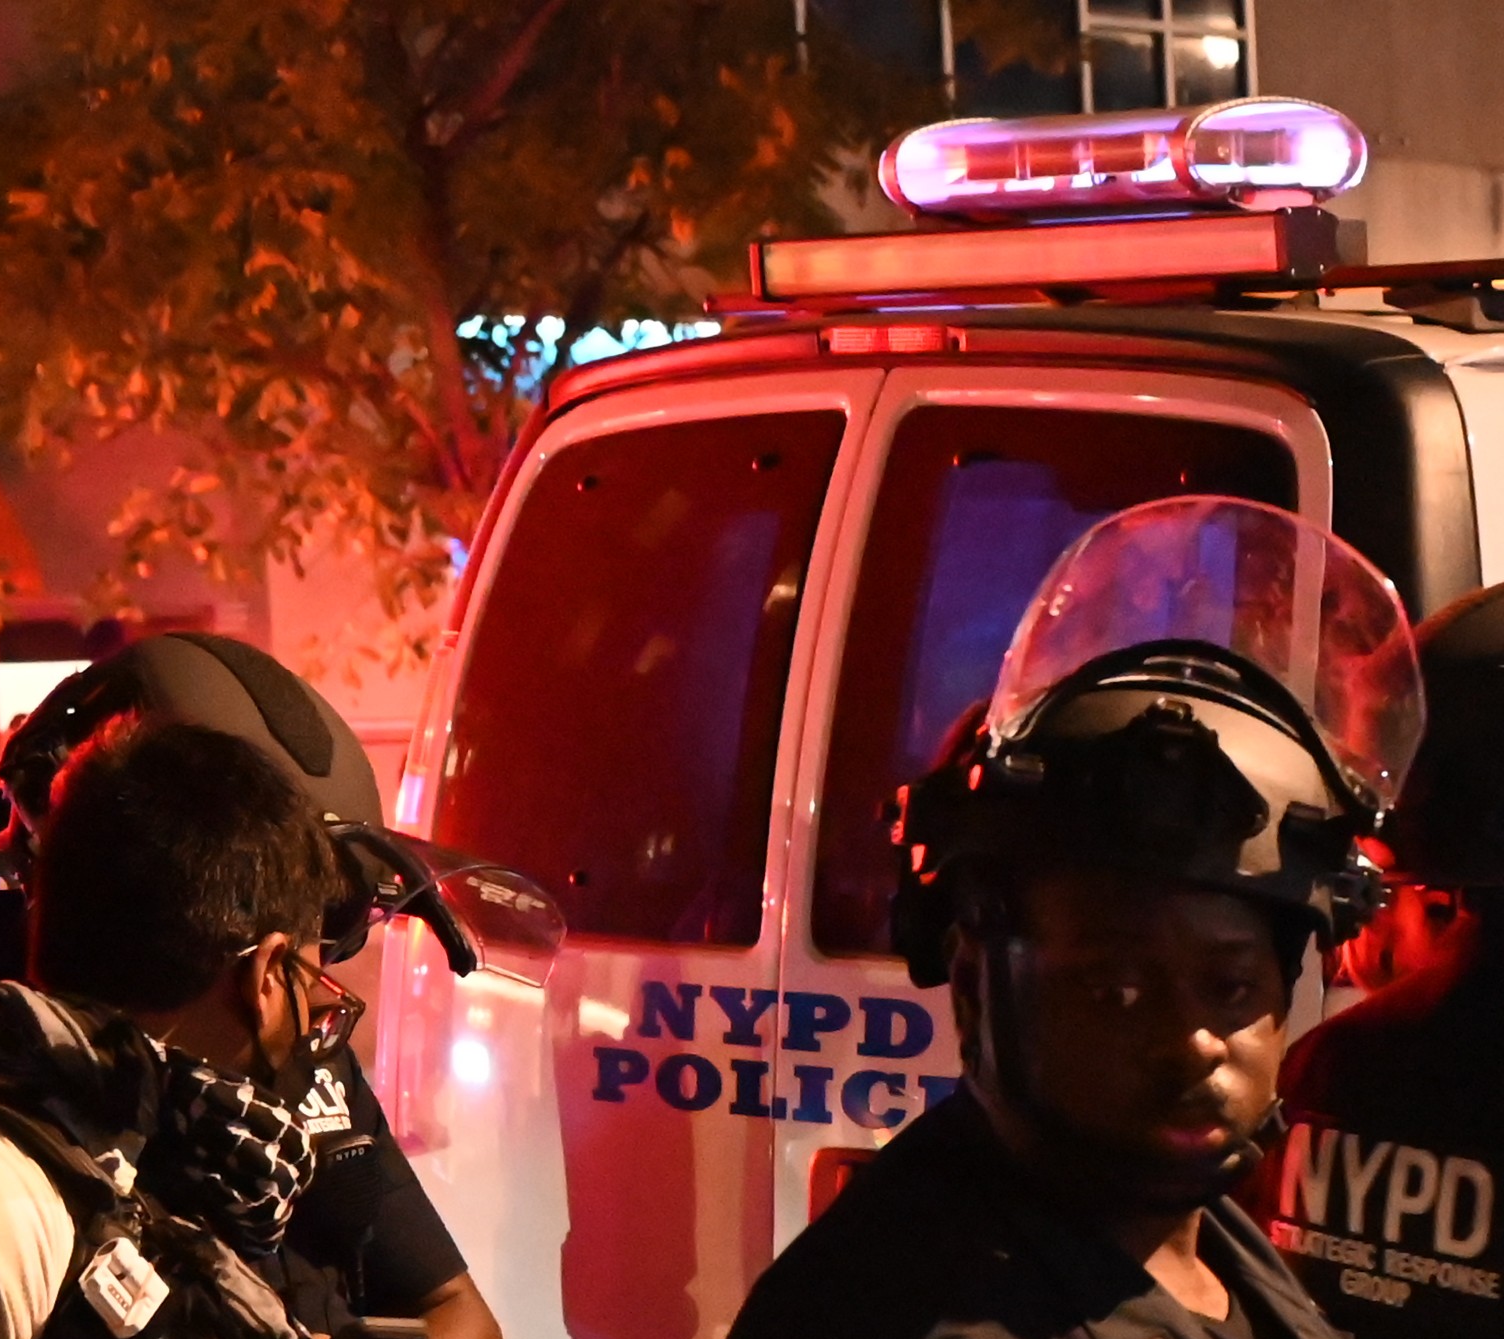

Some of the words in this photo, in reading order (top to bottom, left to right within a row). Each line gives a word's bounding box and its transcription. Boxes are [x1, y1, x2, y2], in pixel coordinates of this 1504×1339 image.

[638, 981, 934, 1059] NYPD
[336, 1147, 365, 1161] NYPD
[1279, 1122, 1495, 1259] NYPD
[1269, 1219, 1378, 1271] STRATEGIC
[1384, 1247, 1502, 1299] RESPONSE
[1339, 1268, 1412, 1308] GROUP
